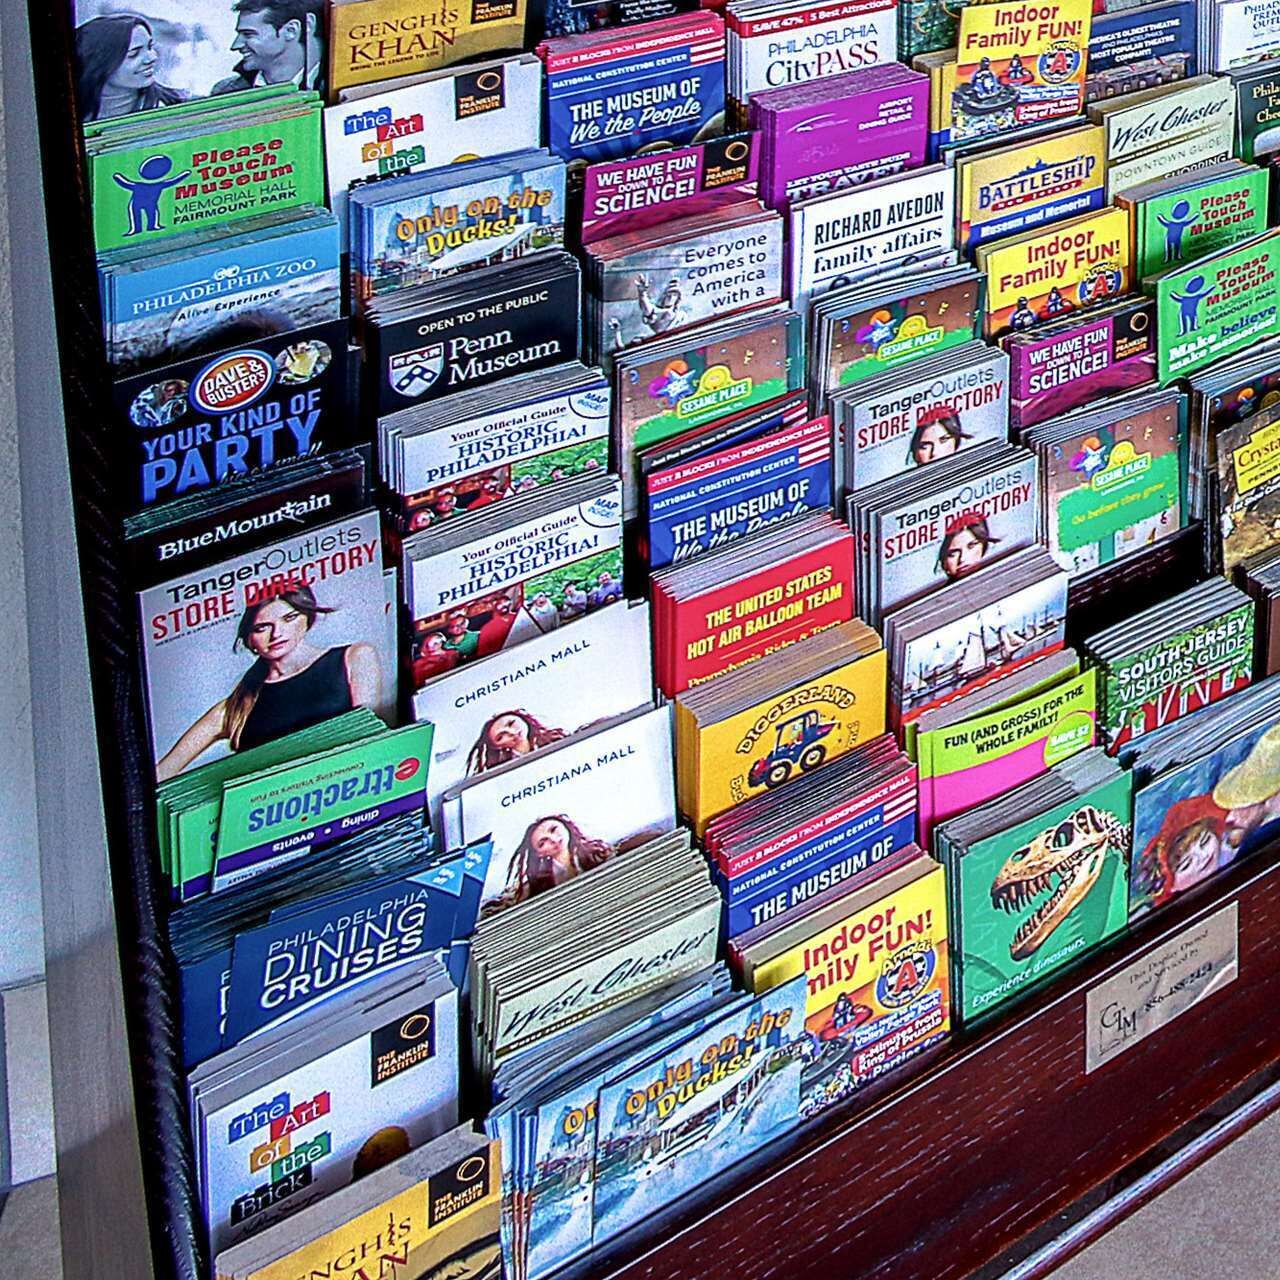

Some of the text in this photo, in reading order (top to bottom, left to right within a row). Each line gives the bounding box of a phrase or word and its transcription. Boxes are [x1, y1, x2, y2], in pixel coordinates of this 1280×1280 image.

[965, 20, 1082, 50] Family FUN!
[995, 3, 1060, 27] Indoor
[350, 26, 456, 64] KHAN
[769, 23, 878, 57] PHILADELPHIA
[570, 78, 700, 122] THE MUSEUM OF
[385, 120, 416, 140] Art
[192, 137, 283, 167] Please
[197, 152, 277, 181] Touch
[597, 155, 697, 187] WE HAVE FUN
[174, 180, 296, 215] MEMORIAL HALL
[175, 163, 294, 200] Museum
[593, 179, 696, 217] SCIENCE!
[978, 153, 1095, 209] BATTLESHIP
[173, 189, 297, 225] FAIRMOUNT PARK
[814, 190, 944, 245] RICHARD AVEDON
[425, 215, 518, 257] Ducks!
[685, 233, 768, 264] Everyone
[813, 226, 943, 274] family affairs
[1027, 230, 1095, 263] Indoor
[132, 258, 317, 314] PHILADELPHIA ZOO
[687, 250, 766, 280] comes to
[692, 267, 766, 296] America
[1000, 239, 1120, 291] Family FUN!
[1216, 252, 1270, 279] Please
[1217, 266, 1266, 291] Touch
[417, 290, 549, 336] OPEN TO THE PUBLIC
[711, 285, 765, 308] with a
[448, 340, 561, 386] Museum
[449, 327, 513, 360] Penn
[203, 358, 263, 393] DAVE &
[207, 371, 266, 407] BUSTER'S
[1029, 349, 1108, 394] SCIENCE!
[143, 388, 321, 461] YOUR KIND OF
[457, 420, 559, 458] HISTORIC
[427, 424, 587, 483] PHILADELPHIA!
[158, 493, 331, 560] BlueMountain
[672, 478, 810, 544] THE MUSEUM OF
[166, 524, 362, 604] TangerOutlets
[437, 534, 599, 606] PHILADELPHIA!
[469, 532, 570, 579] HISTORIC
[706, 565, 833, 629] THE UNITED STATES
[687, 583, 843, 660] HOT AIR BALLOON TEAM
[1119, 613, 1248, 684] SOUTH JERSEY
[454, 640, 591, 708] CHRISTIANA MALL
[736, 685, 857, 755] DIGGERLAND
[944, 732, 969, 749] FUN
[970, 722, 998, 743] (AND
[1000, 708, 1041, 736] GROSS)
[1043, 697, 1064, 715] FOR
[1064, 685, 1085, 704] THE
[975, 732, 1016, 755] WHOLE
[1017, 711, 1059, 741] FAMILY!
[500, 745, 635, 808] CHRISTIANA MALL
[732, 814, 881, 894] NATIONAL CONSTITUTION CENTER
[751, 836, 894, 926] THE MUSEUM OF
[269, 888, 429, 956] PHILADELPHIA
[802, 906, 896, 971] Indoor
[263, 902, 426, 987] DINING
[260, 929, 423, 1010] CRUISES
[972, 967, 1032, 1008] Experience
[377, 1040, 429, 1072] FRANKLIN
[377, 1049, 429, 1081] INSTITUTE
[655, 1045, 753, 1121] Ducks!
[232, 1102, 286, 1137] The
[279, 1100, 320, 1135] Art
[256, 1139, 282, 1165] of
[279, 1142, 323, 1175] the
[433, 1181, 484, 1214] FRANKLIN
